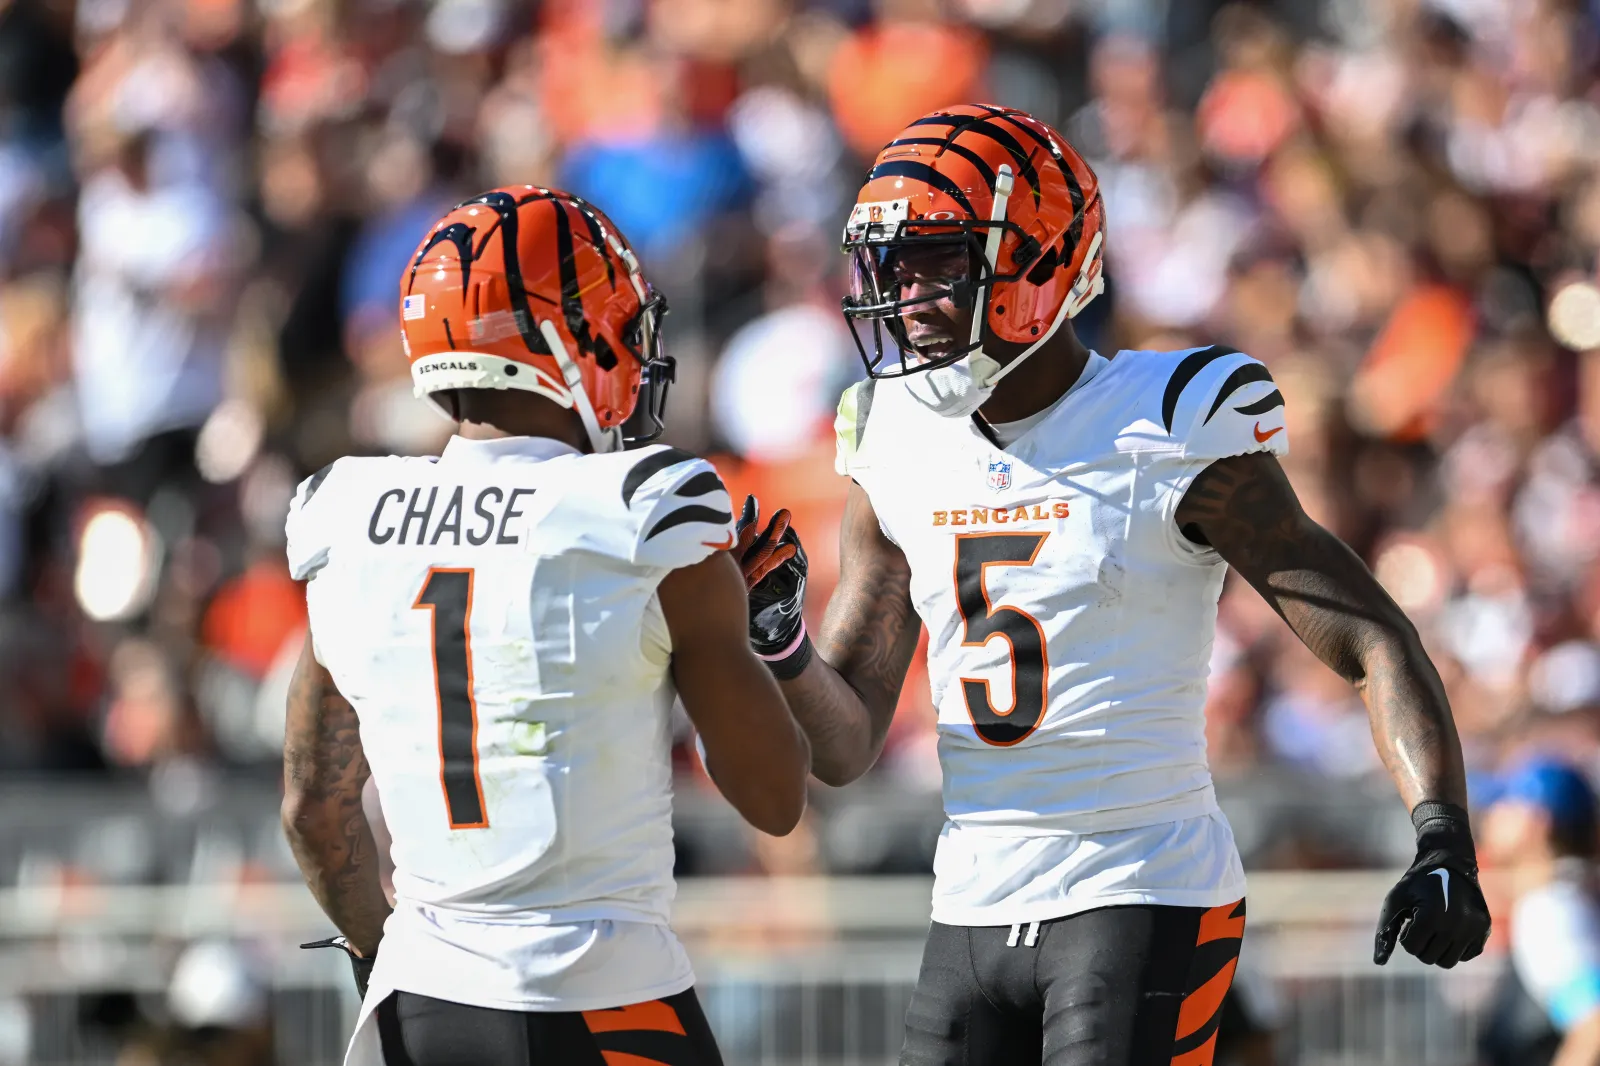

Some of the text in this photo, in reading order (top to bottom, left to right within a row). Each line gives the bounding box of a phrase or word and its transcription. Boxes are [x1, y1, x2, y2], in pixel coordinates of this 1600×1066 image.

[869, 206, 883, 222] B
[419, 362, 477, 374] BENGALS
[368, 486, 536, 546] CHASE
[933, 503, 1070, 526] BENGALS
[953, 531, 1051, 747] 5
[411, 567, 489, 830] 1
